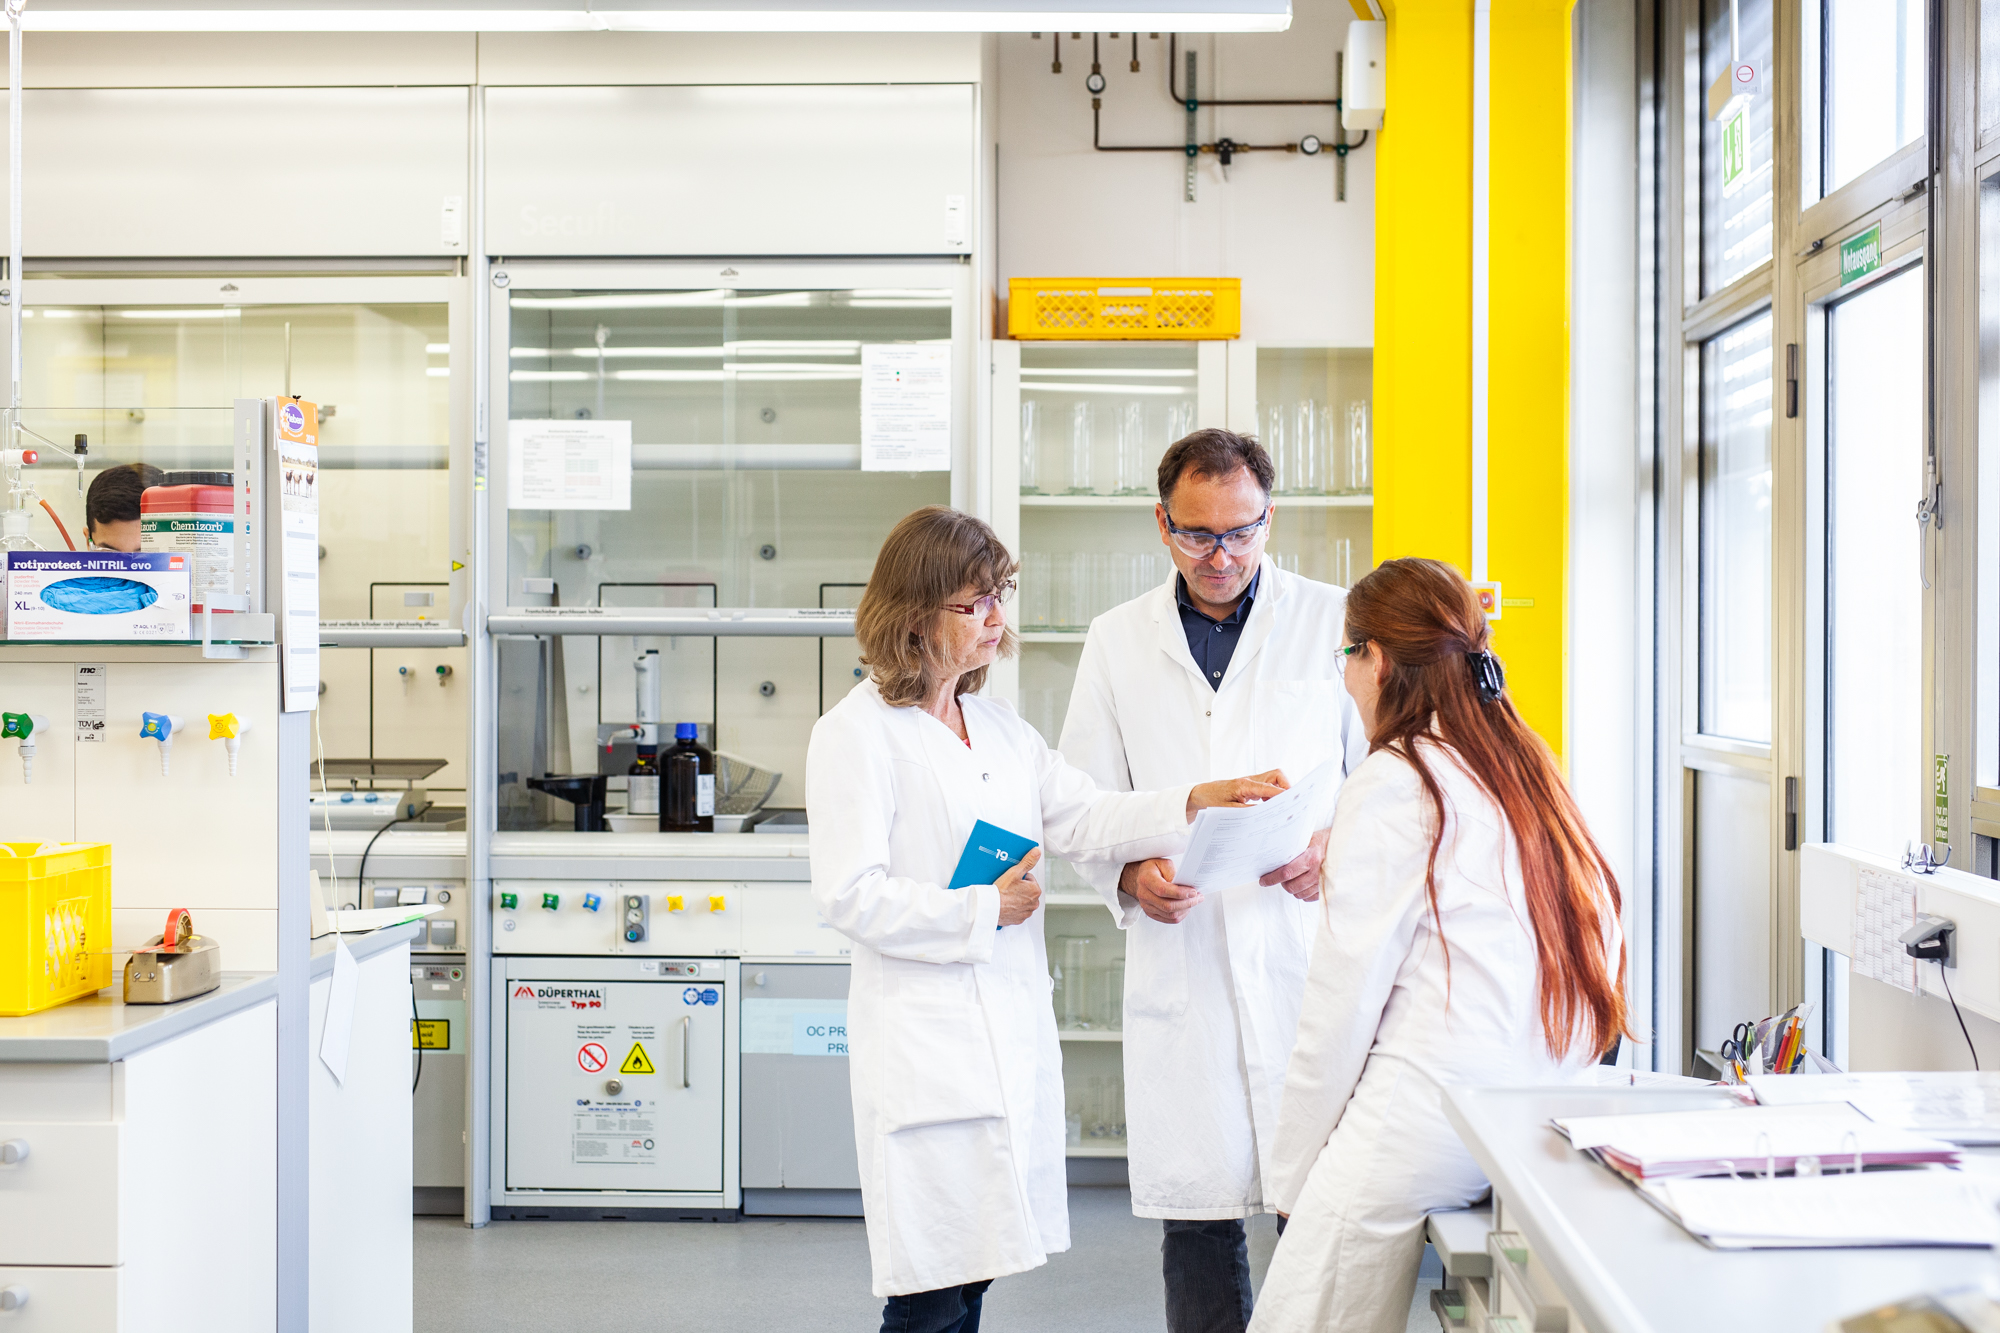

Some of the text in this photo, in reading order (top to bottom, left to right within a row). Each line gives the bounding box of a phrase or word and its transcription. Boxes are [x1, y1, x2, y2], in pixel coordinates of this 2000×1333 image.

[1843, 241, 1878, 275] Notausgang
[141, 522, 157, 531] izorb
[170, 521, 223, 532] Chemizorb
[130, 562, 152, 570] evo
[14, 601, 31, 611] XL
[78, 720, 92, 728] TÜV
[995, 848, 1009, 861] 19
[538, 986, 601, 998] DÜPERTHAL
[571, 1000, 587, 1010] Typ
[589, 1000, 602, 1009] 90
[806, 1026, 826, 1036] OC
